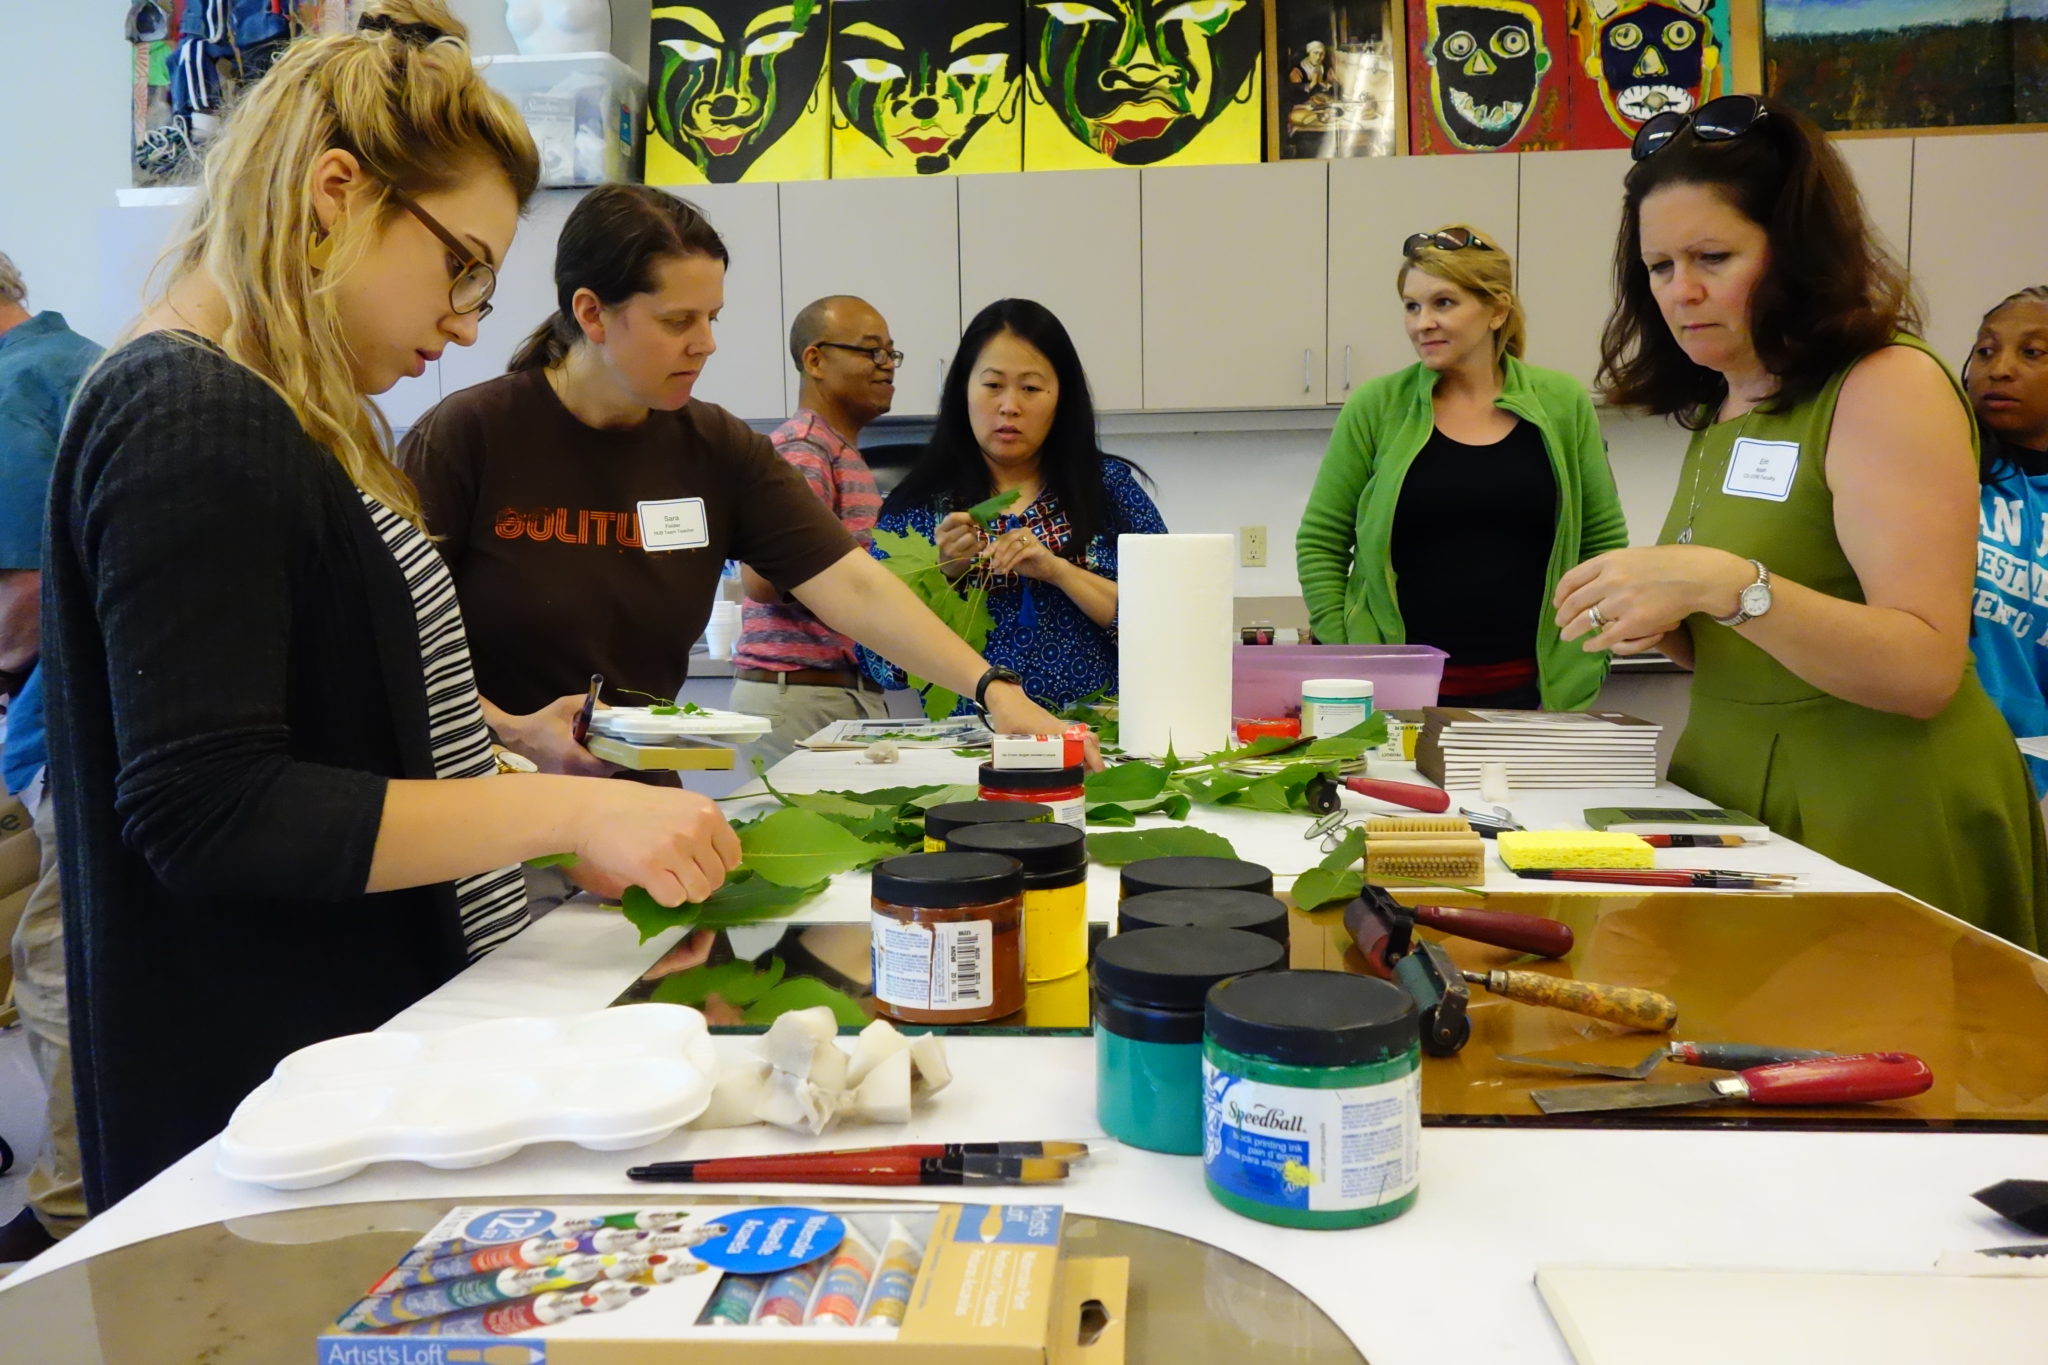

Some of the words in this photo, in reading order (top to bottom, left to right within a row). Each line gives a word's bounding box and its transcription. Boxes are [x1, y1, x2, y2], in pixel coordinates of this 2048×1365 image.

[1227, 1100, 1305, 1132] Speedball
[1253, 1138, 1287, 1153] printing
[1288, 1143, 1303, 1153] ink
[486, 1210, 542, 1231] 12
[328, 1343, 400, 1365] Artist's
[402, 1343, 443, 1365] Loft
